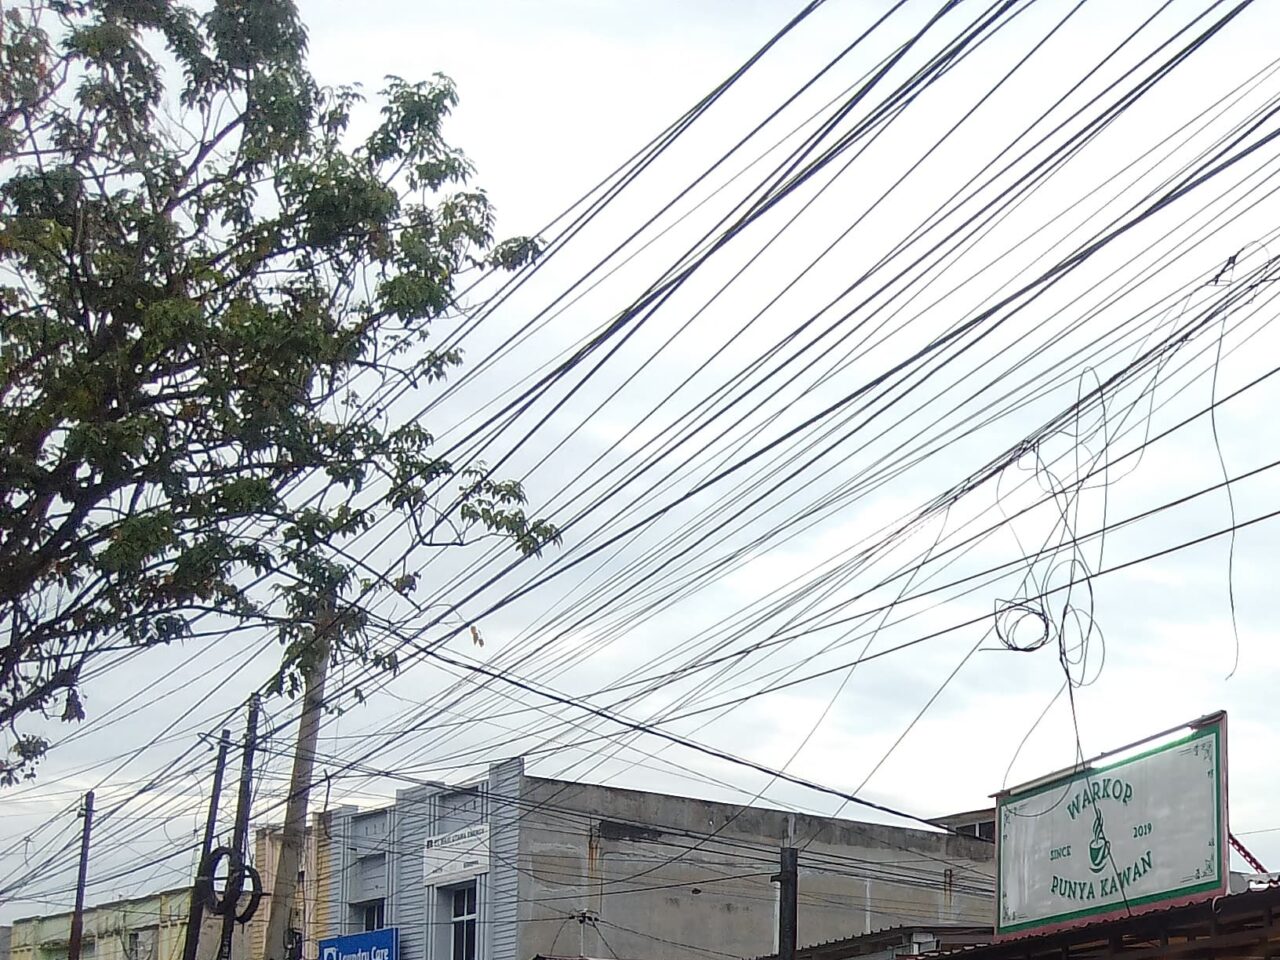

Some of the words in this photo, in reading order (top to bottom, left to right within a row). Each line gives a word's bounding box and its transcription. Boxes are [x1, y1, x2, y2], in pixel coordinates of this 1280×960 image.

[1066, 778, 1133, 819] WARKOP
[1132, 823, 1152, 838] 2019
[1050, 845, 1071, 861] SINCE
[1051, 876, 1096, 900] PUNYA
[1100, 851, 1152, 897] KAWAN
